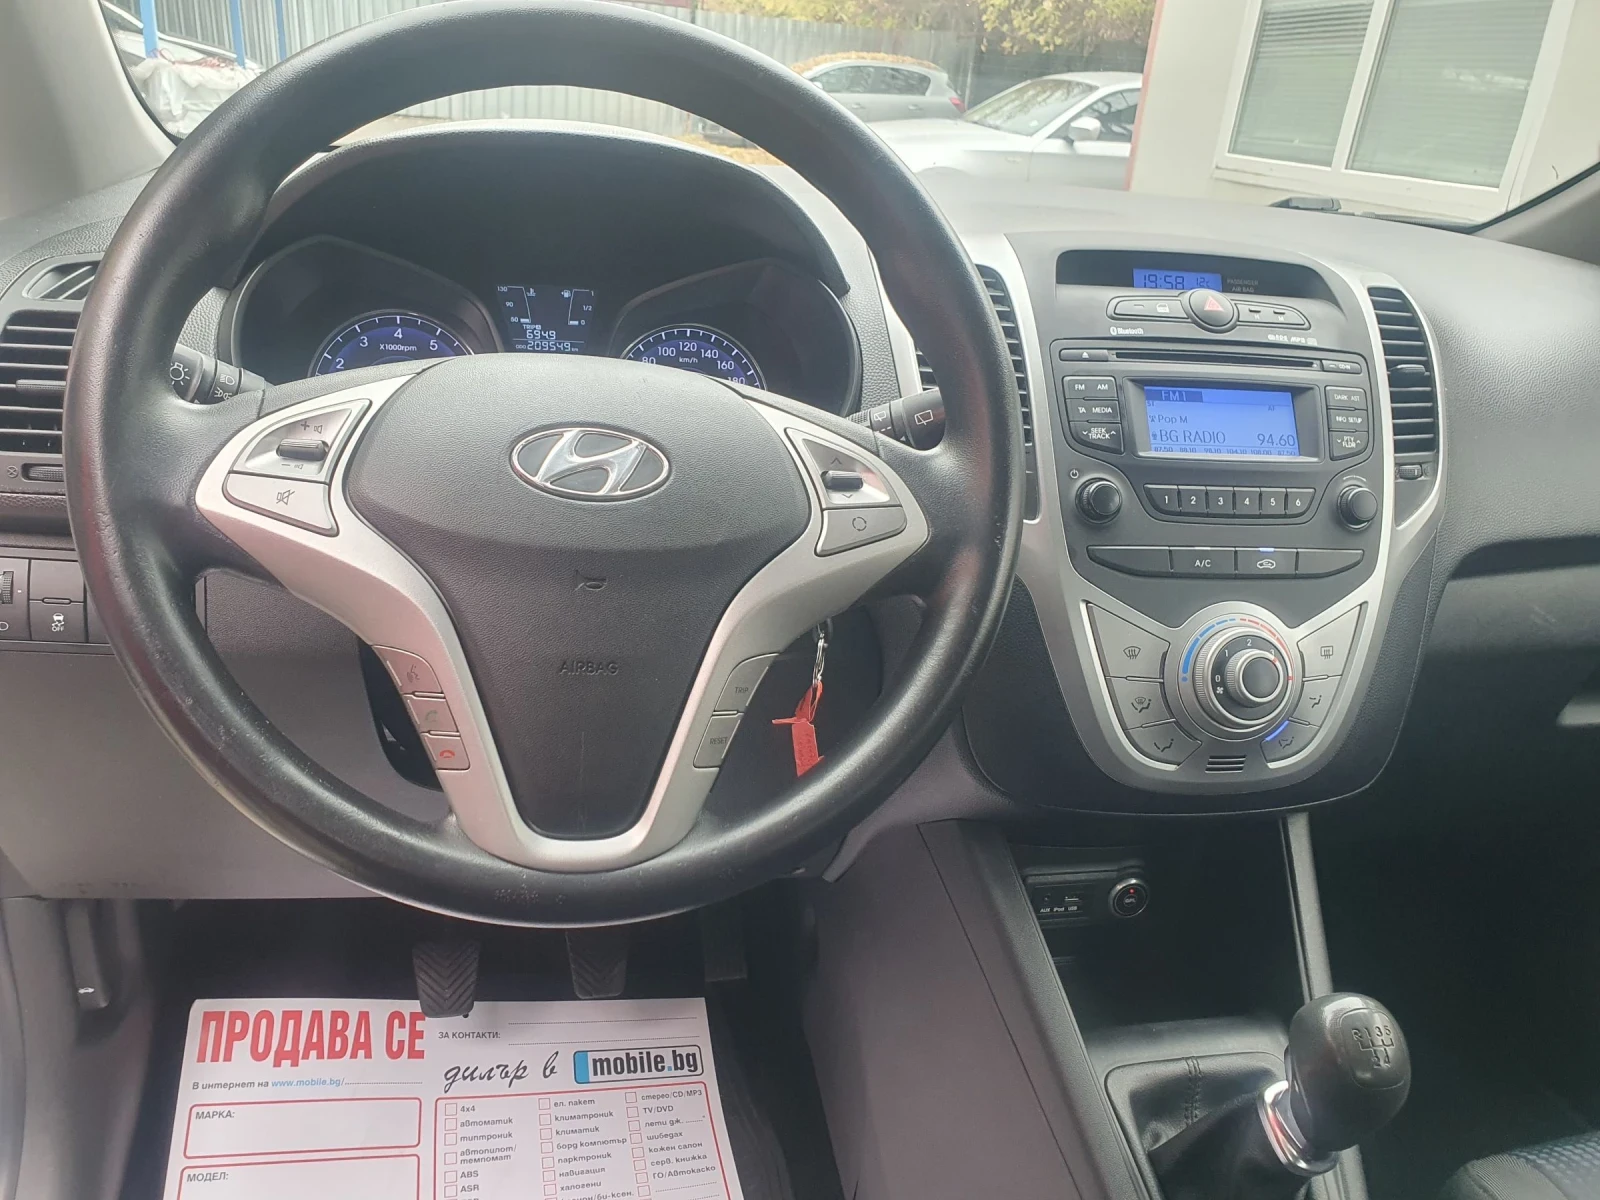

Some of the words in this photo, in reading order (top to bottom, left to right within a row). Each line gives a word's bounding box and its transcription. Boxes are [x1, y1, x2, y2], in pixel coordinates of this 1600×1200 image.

[1144, 274, 1185, 290] 19:58
[1226, 278, 1259, 286] PASSENGER
[394, 328, 403, 339] 4
[1116, 327, 1144, 335] Bluetooth
[360, 336, 368, 347] 3
[429, 339, 438, 350] 5
[527, 341, 571, 352] 209549
[380, 344, 418, 352] X1000rpm
[658, 346, 676, 357] 100
[678, 342, 698, 352] 120
[700, 349, 719, 359] 140
[336, 358, 344, 370] 2
[679, 356, 698, 364] km/h
[717, 360, 735, 370] 160
[1158, 414, 1178, 424] Pop
[1180, 416, 1188, 424] M
[1159, 429, 1179, 442] BG
[1182, 430, 1226, 444] RADIO
[1256, 433, 1296, 447] 94.60
[1164, 496, 1169, 504] 1
[1190, 496, 1196, 504] 2
[1218, 497, 1224, 505] 3
[1244, 498, 1250, 506] 4
[1270, 498, 1276, 506] 5
[1295, 498, 1301, 506] 6
[1194, 560, 1211, 568] A/C
[560, 660, 619, 676] AIRBAG
[1215, 674, 1220, 682] 0
[734, 686, 748, 694] TRIP
[710, 736, 728, 744] RESET
[452, 1032, 501, 1040] КОНТАКТИ:
[1352, 1028, 1363, 1040] R
[1374, 1026, 1383, 1037] 3
[1384, 1025, 1392, 1036] 5
[196, 1010, 372, 1068] ПРОДАВА
[385, 1010, 426, 1060] СЕ
[443, 1060, 530, 1094] дилър
[592, 1050, 699, 1077] mobile.bg
[192, 1082, 200, 1090] В
[202, 1080, 256, 1090] интернет
[258, 1080, 269, 1088] на
[642, 1090, 702, 1100] стерео/CD/MP3
[568, 1098, 596, 1106] пакет
[643, 1105, 674, 1114] TV/DVD
[195, 1110, 236, 1120] МАРКА:
[554, 1111, 614, 1122] климатроник
[460, 1117, 514, 1128] автоматик
[644, 1120, 667, 1128] лети
[556, 1126, 600, 1136] климатик
[460, 1132, 513, 1142] типтроник
[646, 1132, 683, 1141] шибедах
[556, 1142, 578, 1150] борд
[580, 1138, 628, 1148] компютър
[648, 1146, 676, 1154] кожен
[678, 1142, 703, 1150] салон
[460, 1144, 517, 1156] автопилот/
[460, 1154, 512, 1165] темпомат
[558, 1152, 612, 1164] парктроник
[676, 1154, 708, 1164] книжка
[186, 1172, 229, 1182] МОДЕЛ:
[460, 1170, 479, 1179] ABS
[559, 1167, 606, 1178] навигация
[652, 1166, 716, 1180] ГО/Автокаско
[460, 1184, 480, 1192] ASR
[560, 1181, 602, 1192] халогени
